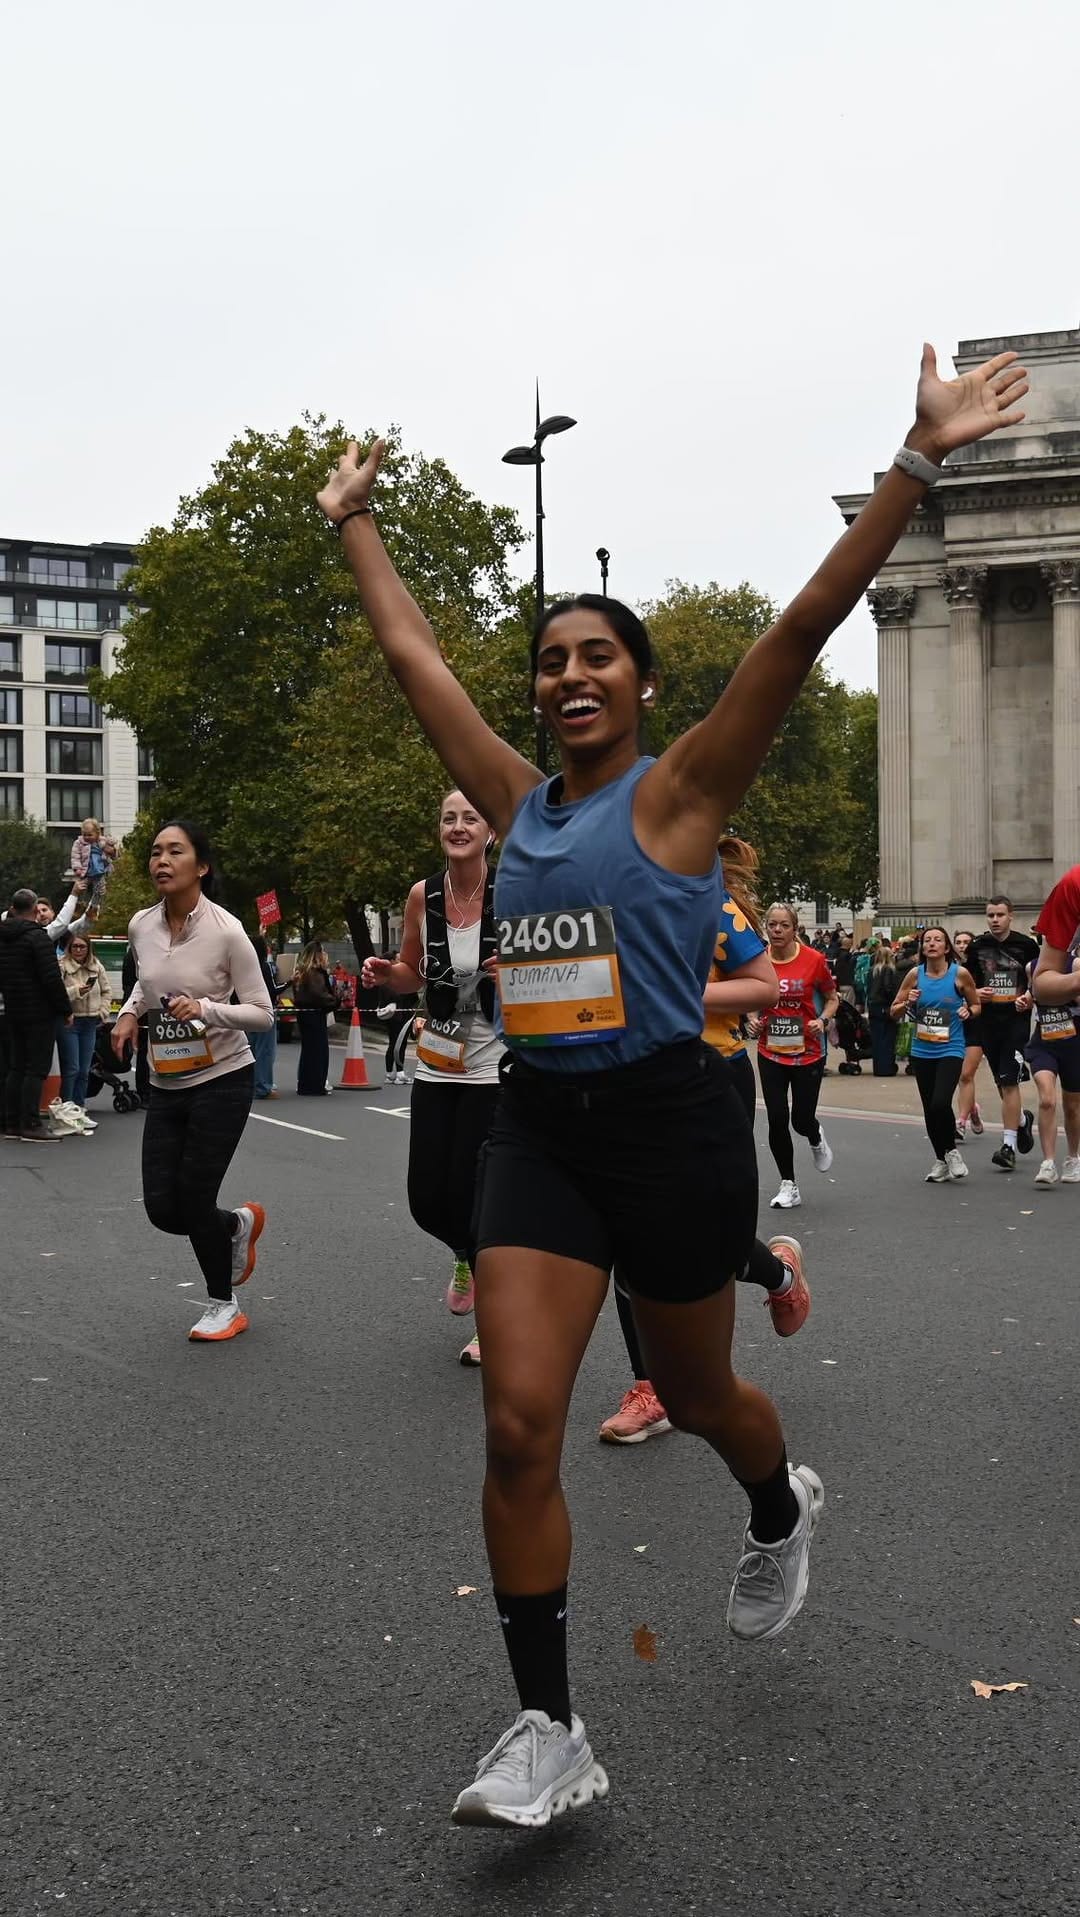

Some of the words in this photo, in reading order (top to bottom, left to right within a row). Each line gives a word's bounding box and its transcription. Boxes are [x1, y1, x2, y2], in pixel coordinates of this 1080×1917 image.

[499, 912, 597, 955] 24601
[509, 963, 580, 986] SUMANA
[771, 1024, 799, 1034] 13728
